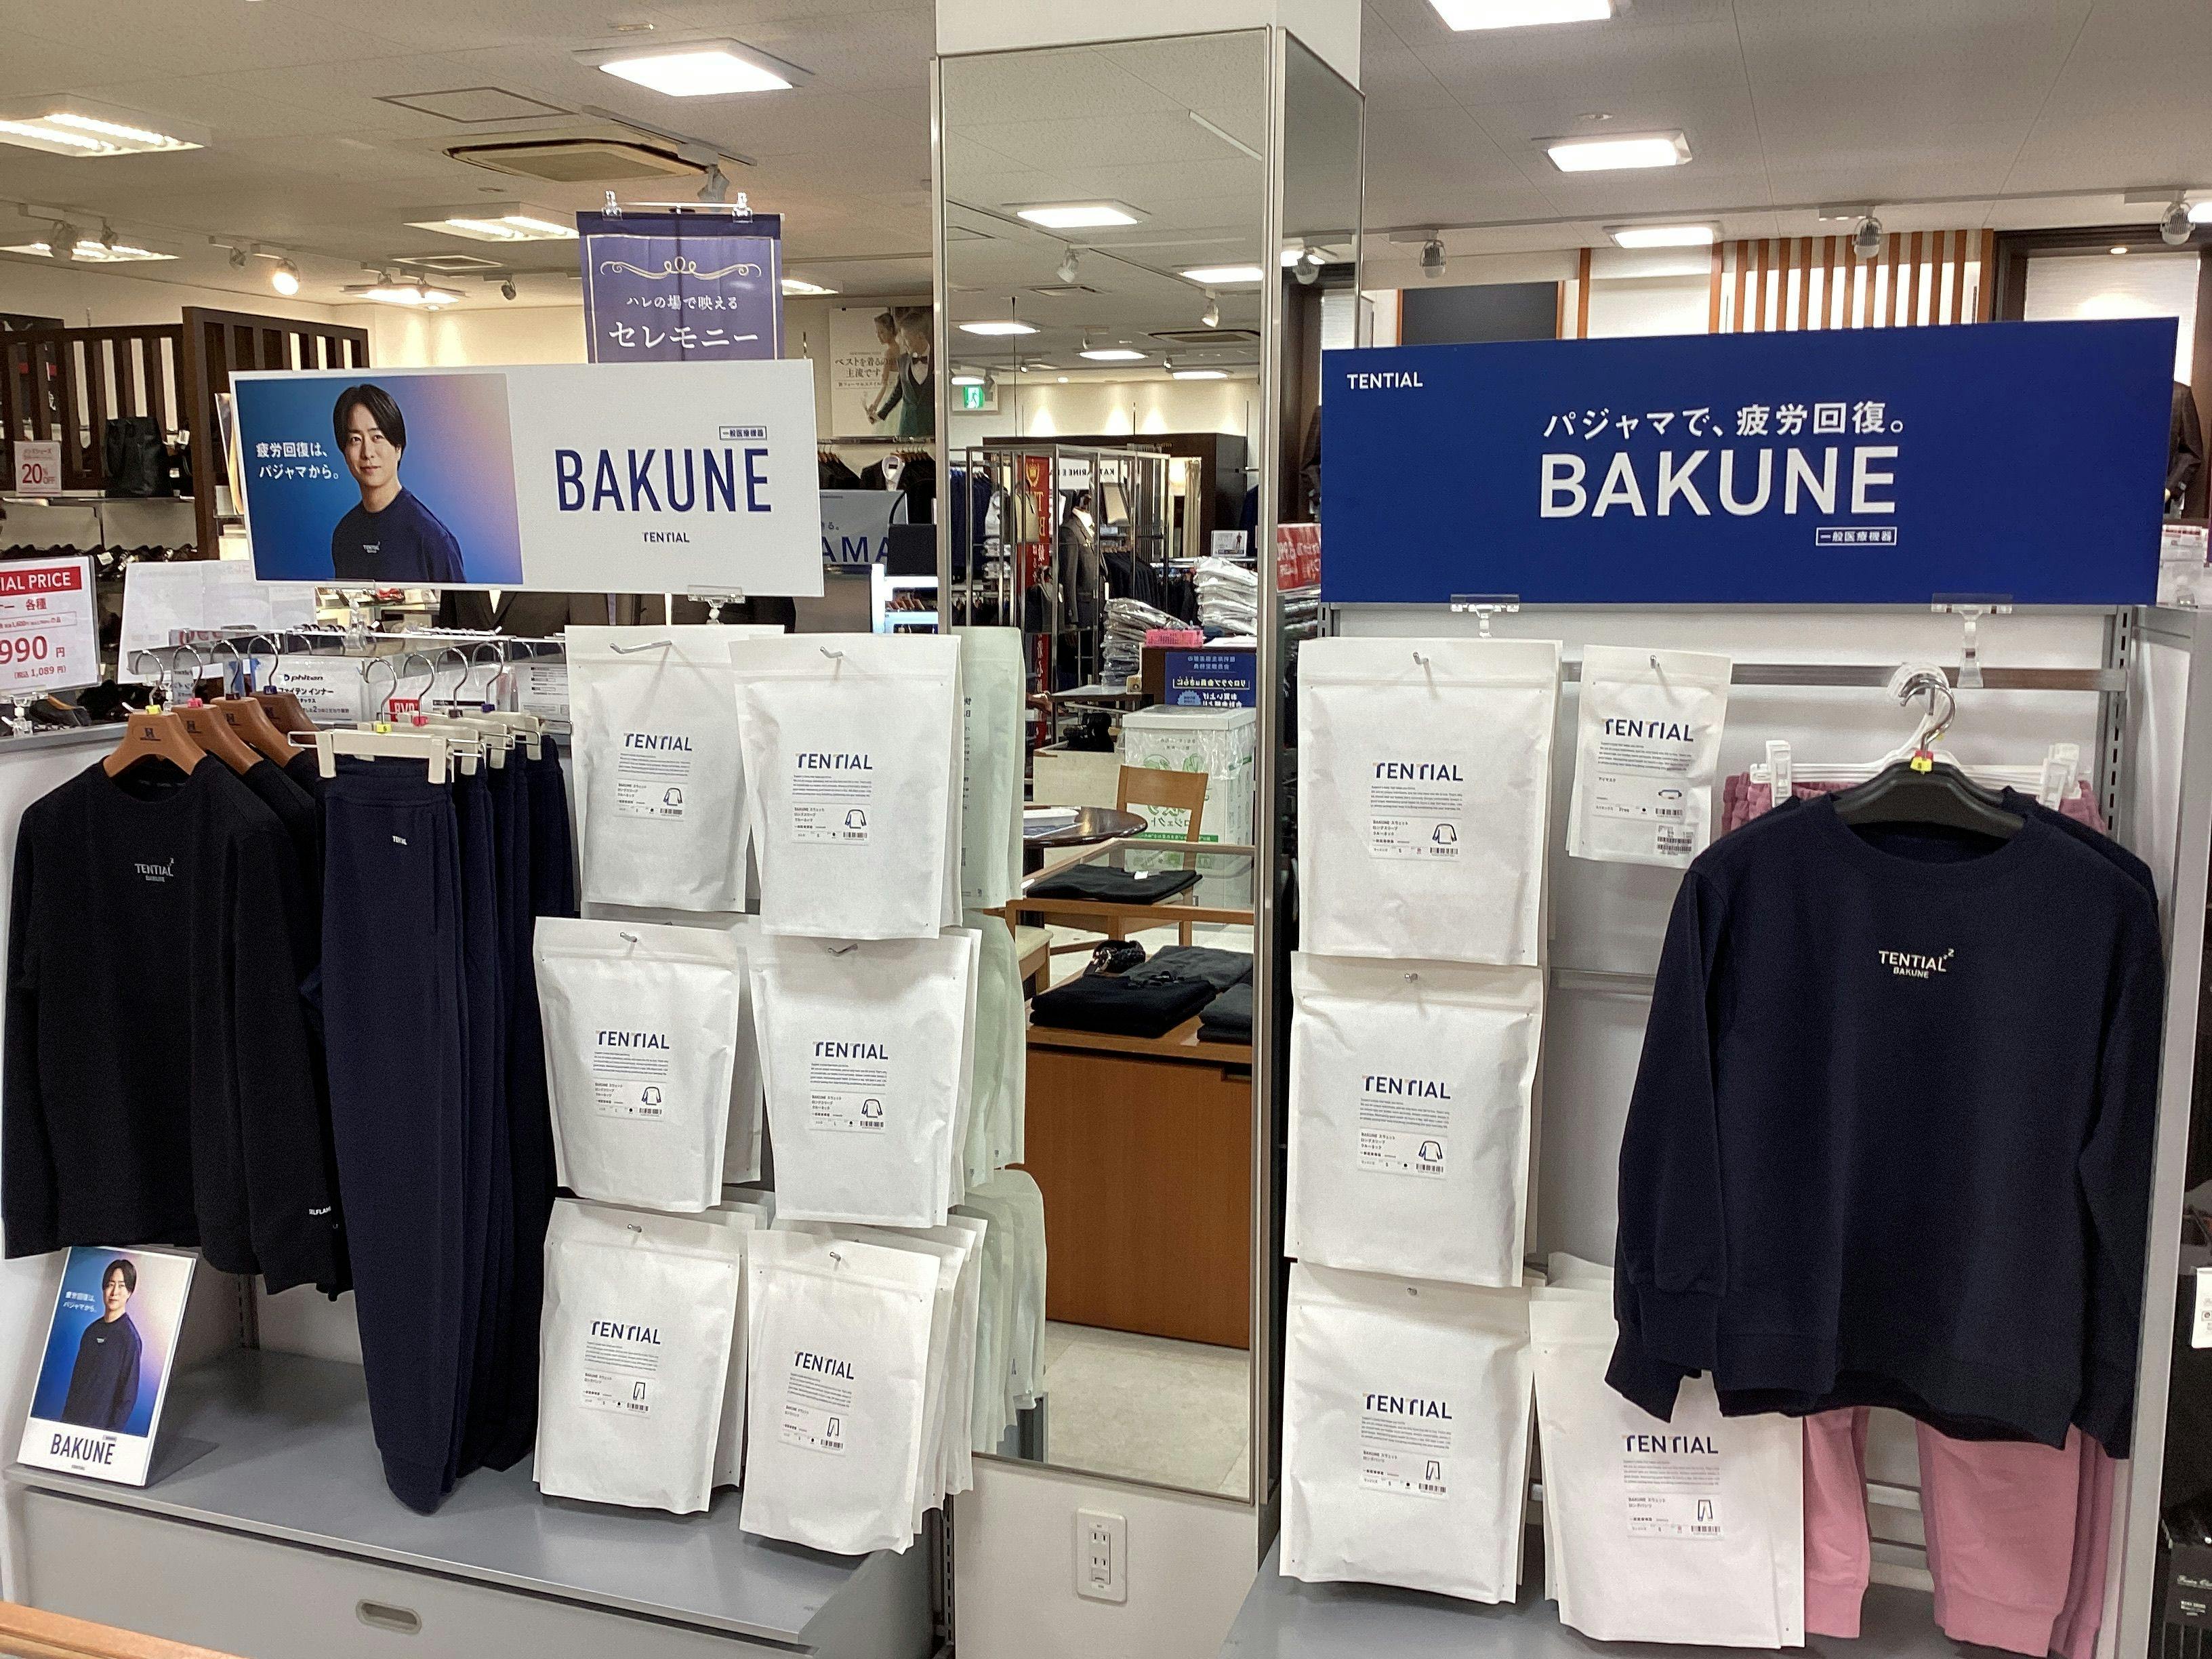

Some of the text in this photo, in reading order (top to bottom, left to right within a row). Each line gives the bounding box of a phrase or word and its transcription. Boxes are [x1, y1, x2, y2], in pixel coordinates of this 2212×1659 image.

[626, 295, 737, 310] ハレの場で映える
[609, 321, 758, 349] セレモニー
[1347, 371, 1422, 390] TENTIAL
[1543, 401, 1904, 441] パジャマで、疲労回復。
[256, 442, 327, 457] 疲労回復は、
[22, 464, 43, 483] 20
[260, 464, 338, 479] パジャマから。
[555, 449, 771, 512] BAKUNE
[1540, 446, 1898, 517] BAKUNE
[642, 532, 690, 542] TENTIAL
[28, 572, 72, 589] PRICE
[56, 647, 65, 658] 円
[31, 666, 55, 678] 1,089
[308, 687, 334, 695] インナー
[1601, 718, 1694, 742] TENTIAL
[623, 733, 692, 751] TENTIAL
[796, 753, 873, 770] TENTIAL
[1372, 762, 1463, 781] TENTIAL
[134, 863, 173, 877] TENTIAL
[1879, 950, 1946, 972] TENTIAL
[1893, 966, 1929, 979] BAKUNE
[596, 1030, 670, 1049] TENTIAL
[813, 1041, 888, 1060] TENTIAL
[1362, 1075, 1451, 1099] TENTIAL
[590, 1320, 661, 1345] TENTIAL
[794, 1351, 854, 1380] TENTIAL
[1362, 1393, 1452, 1419] TENTIAL
[50, 1433, 115, 1465] BAKUNE
[1621, 1435, 1718, 1454] TENTIAL
